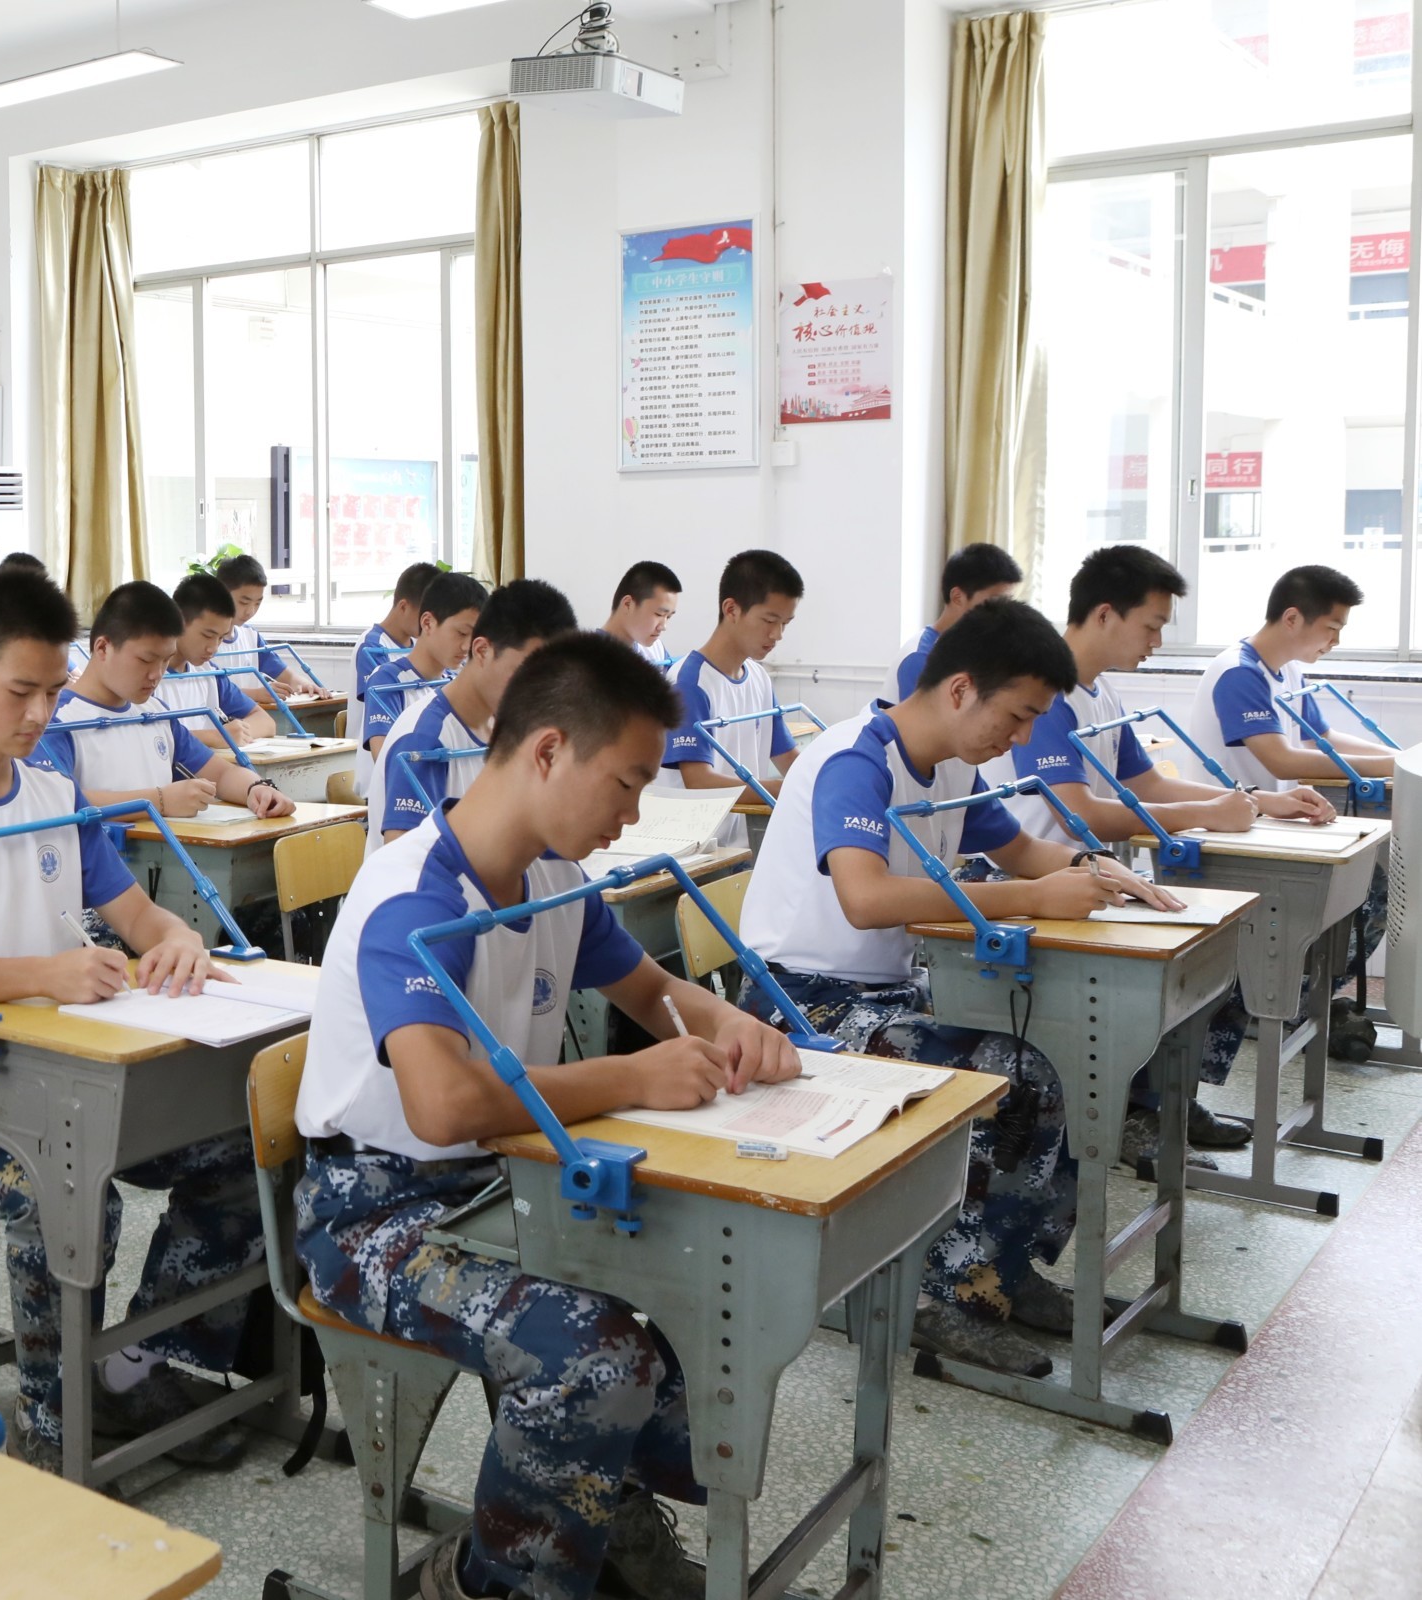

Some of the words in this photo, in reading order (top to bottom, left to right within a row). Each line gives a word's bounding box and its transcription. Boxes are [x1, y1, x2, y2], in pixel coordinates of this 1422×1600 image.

[792, 322, 878, 342] 核心价值观
[1206, 458, 1257, 476] 同行
[1242, 711, 1271, 719] TASAF
[1036, 755, 1068, 766] TASAF
[843, 816, 884, 832] TASAF
